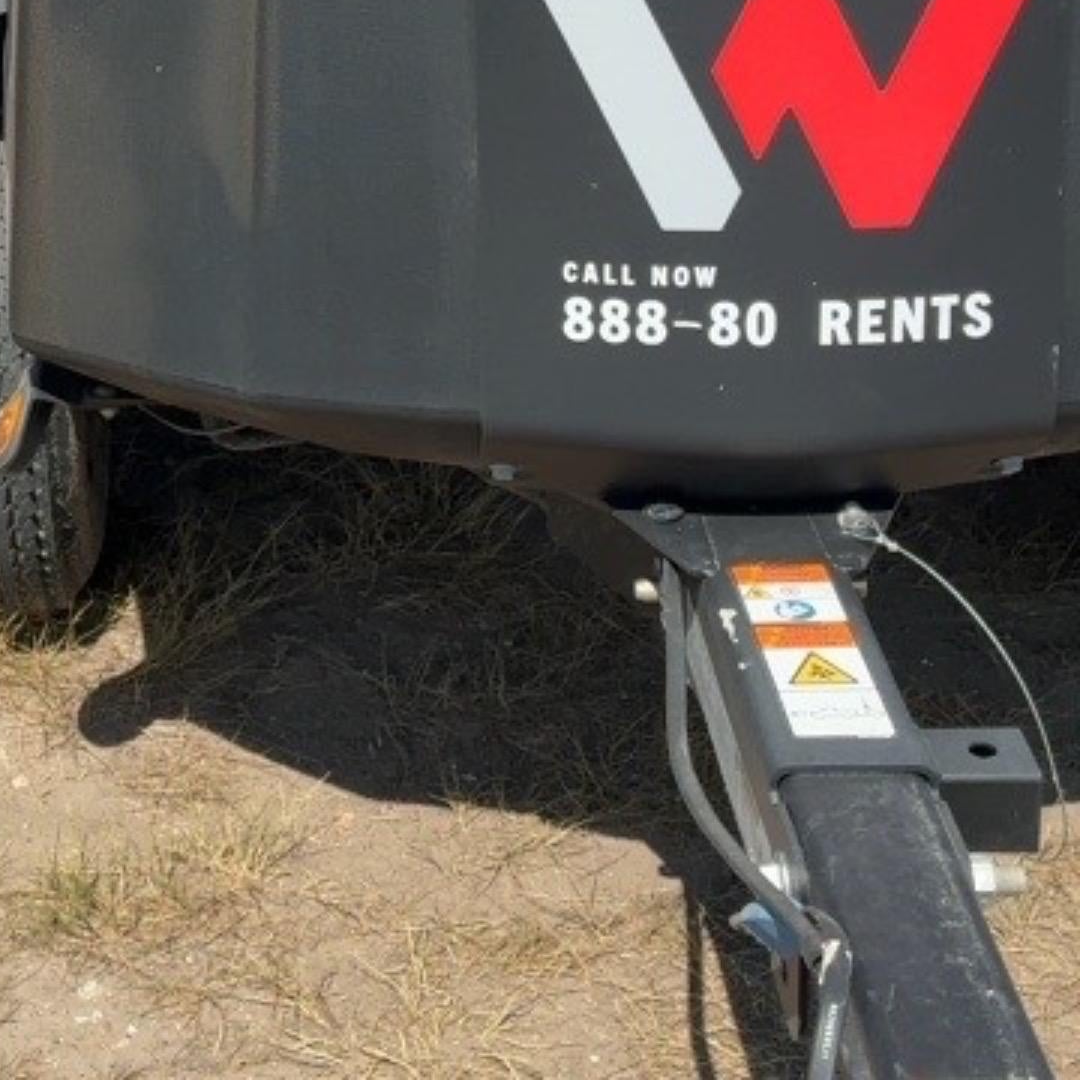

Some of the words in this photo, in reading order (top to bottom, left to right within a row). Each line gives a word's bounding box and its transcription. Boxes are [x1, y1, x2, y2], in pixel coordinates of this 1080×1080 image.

[562, 261, 636, 286] CALL
[651, 266, 718, 288] NOW
[563, 296, 778, 347] 888-80
[819, 291, 994, 346] RENTS
